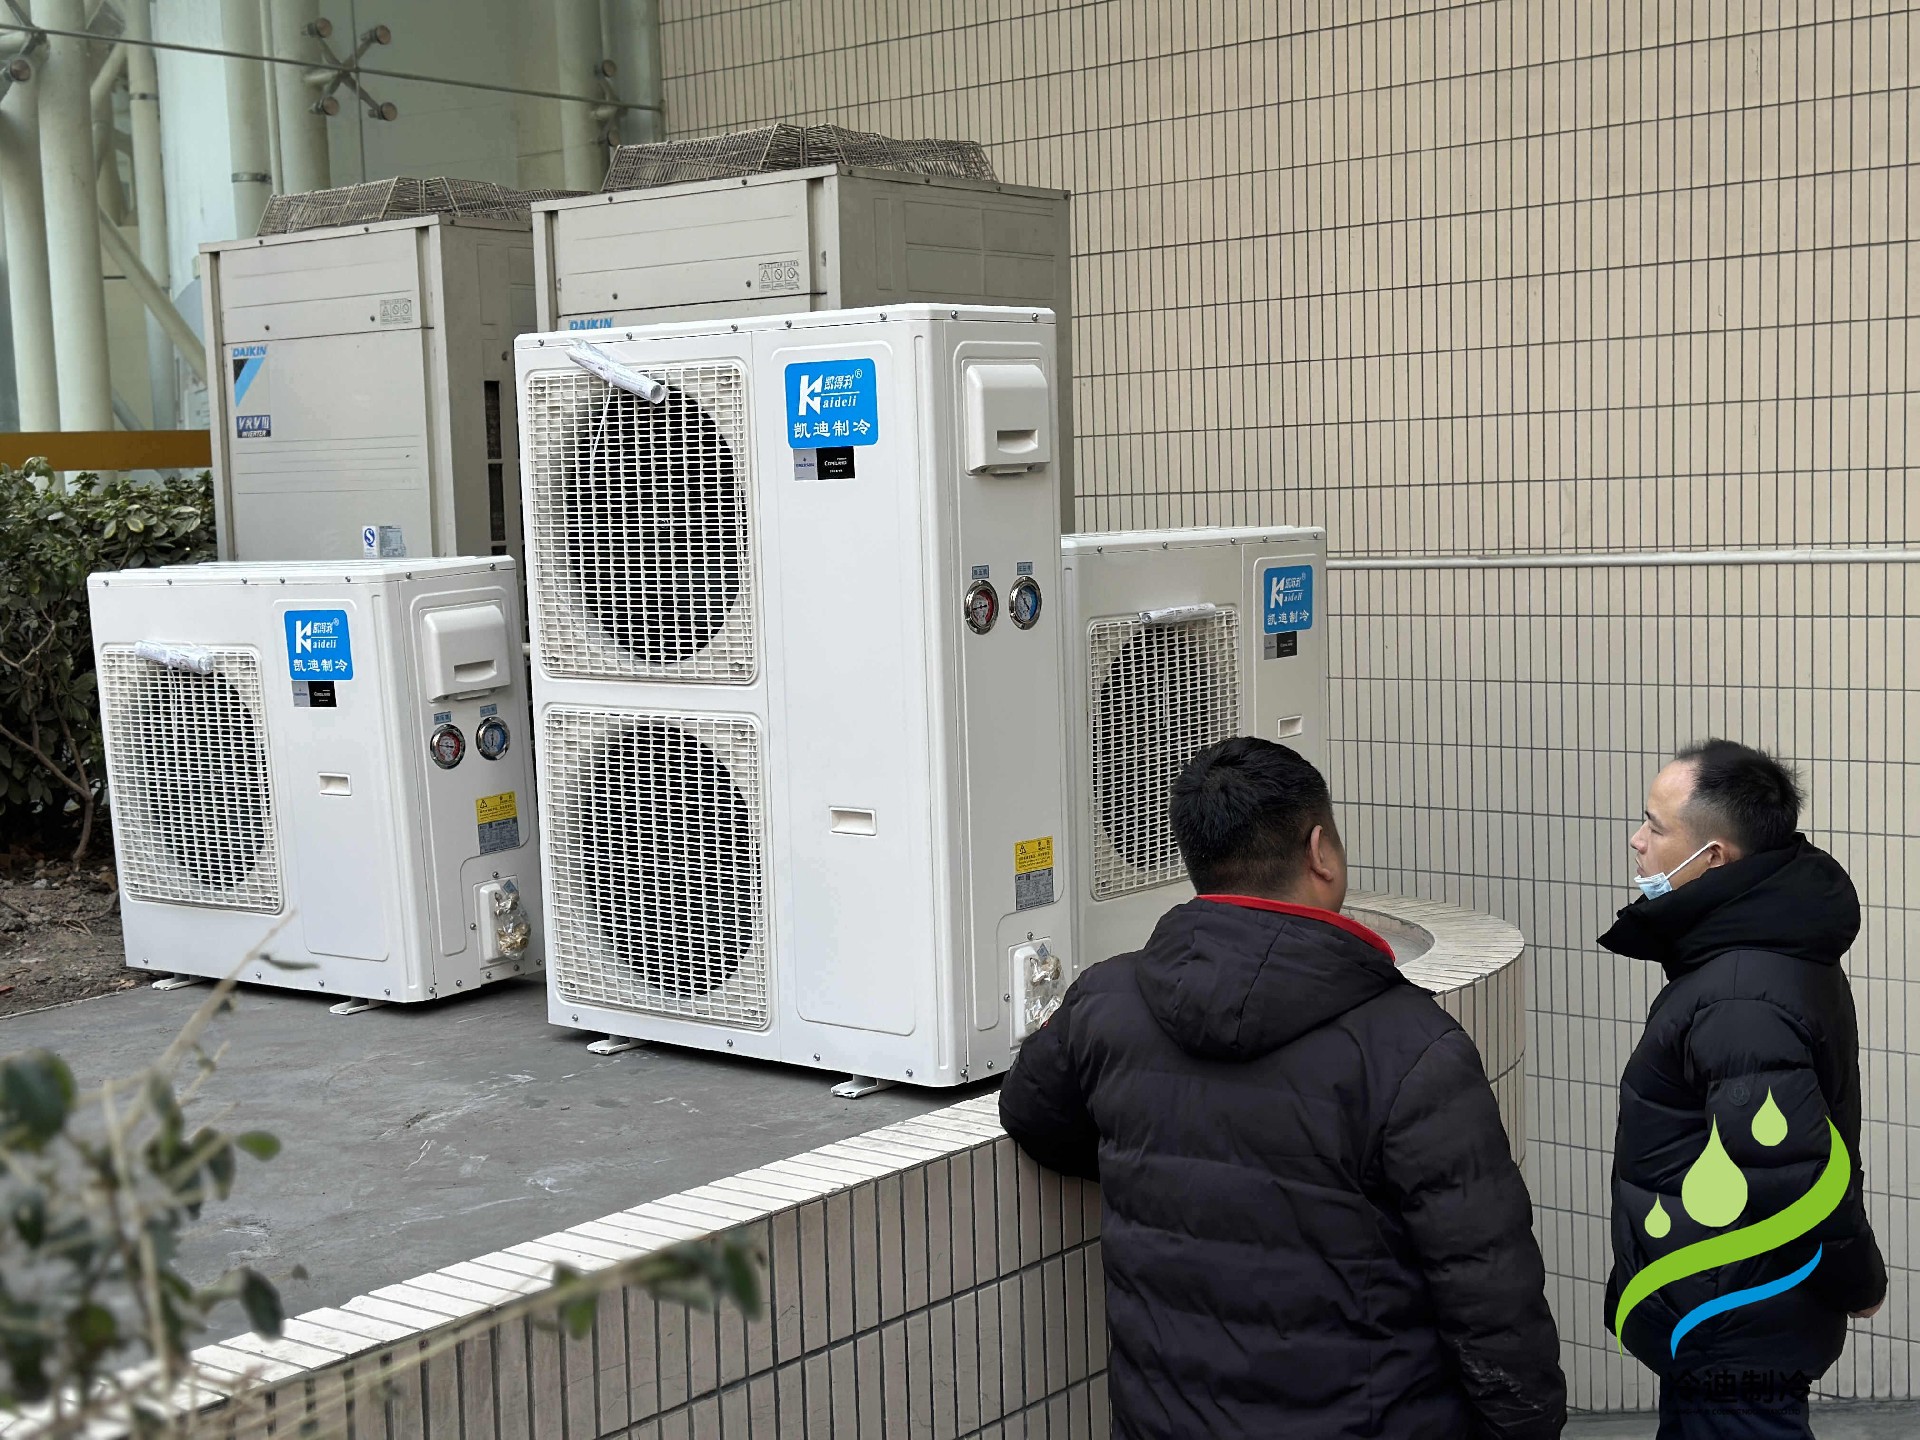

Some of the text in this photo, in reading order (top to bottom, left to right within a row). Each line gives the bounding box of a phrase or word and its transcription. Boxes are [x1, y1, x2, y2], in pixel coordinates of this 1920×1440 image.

[569, 317, 613, 331] DAIKIN
[232, 346, 266, 357] DAIKIN
[794, 419, 871, 439] 凯迪制冷
[1267, 610, 1309, 625] 凯迪制冷
[293, 659, 348, 672] 凯迪制冷
